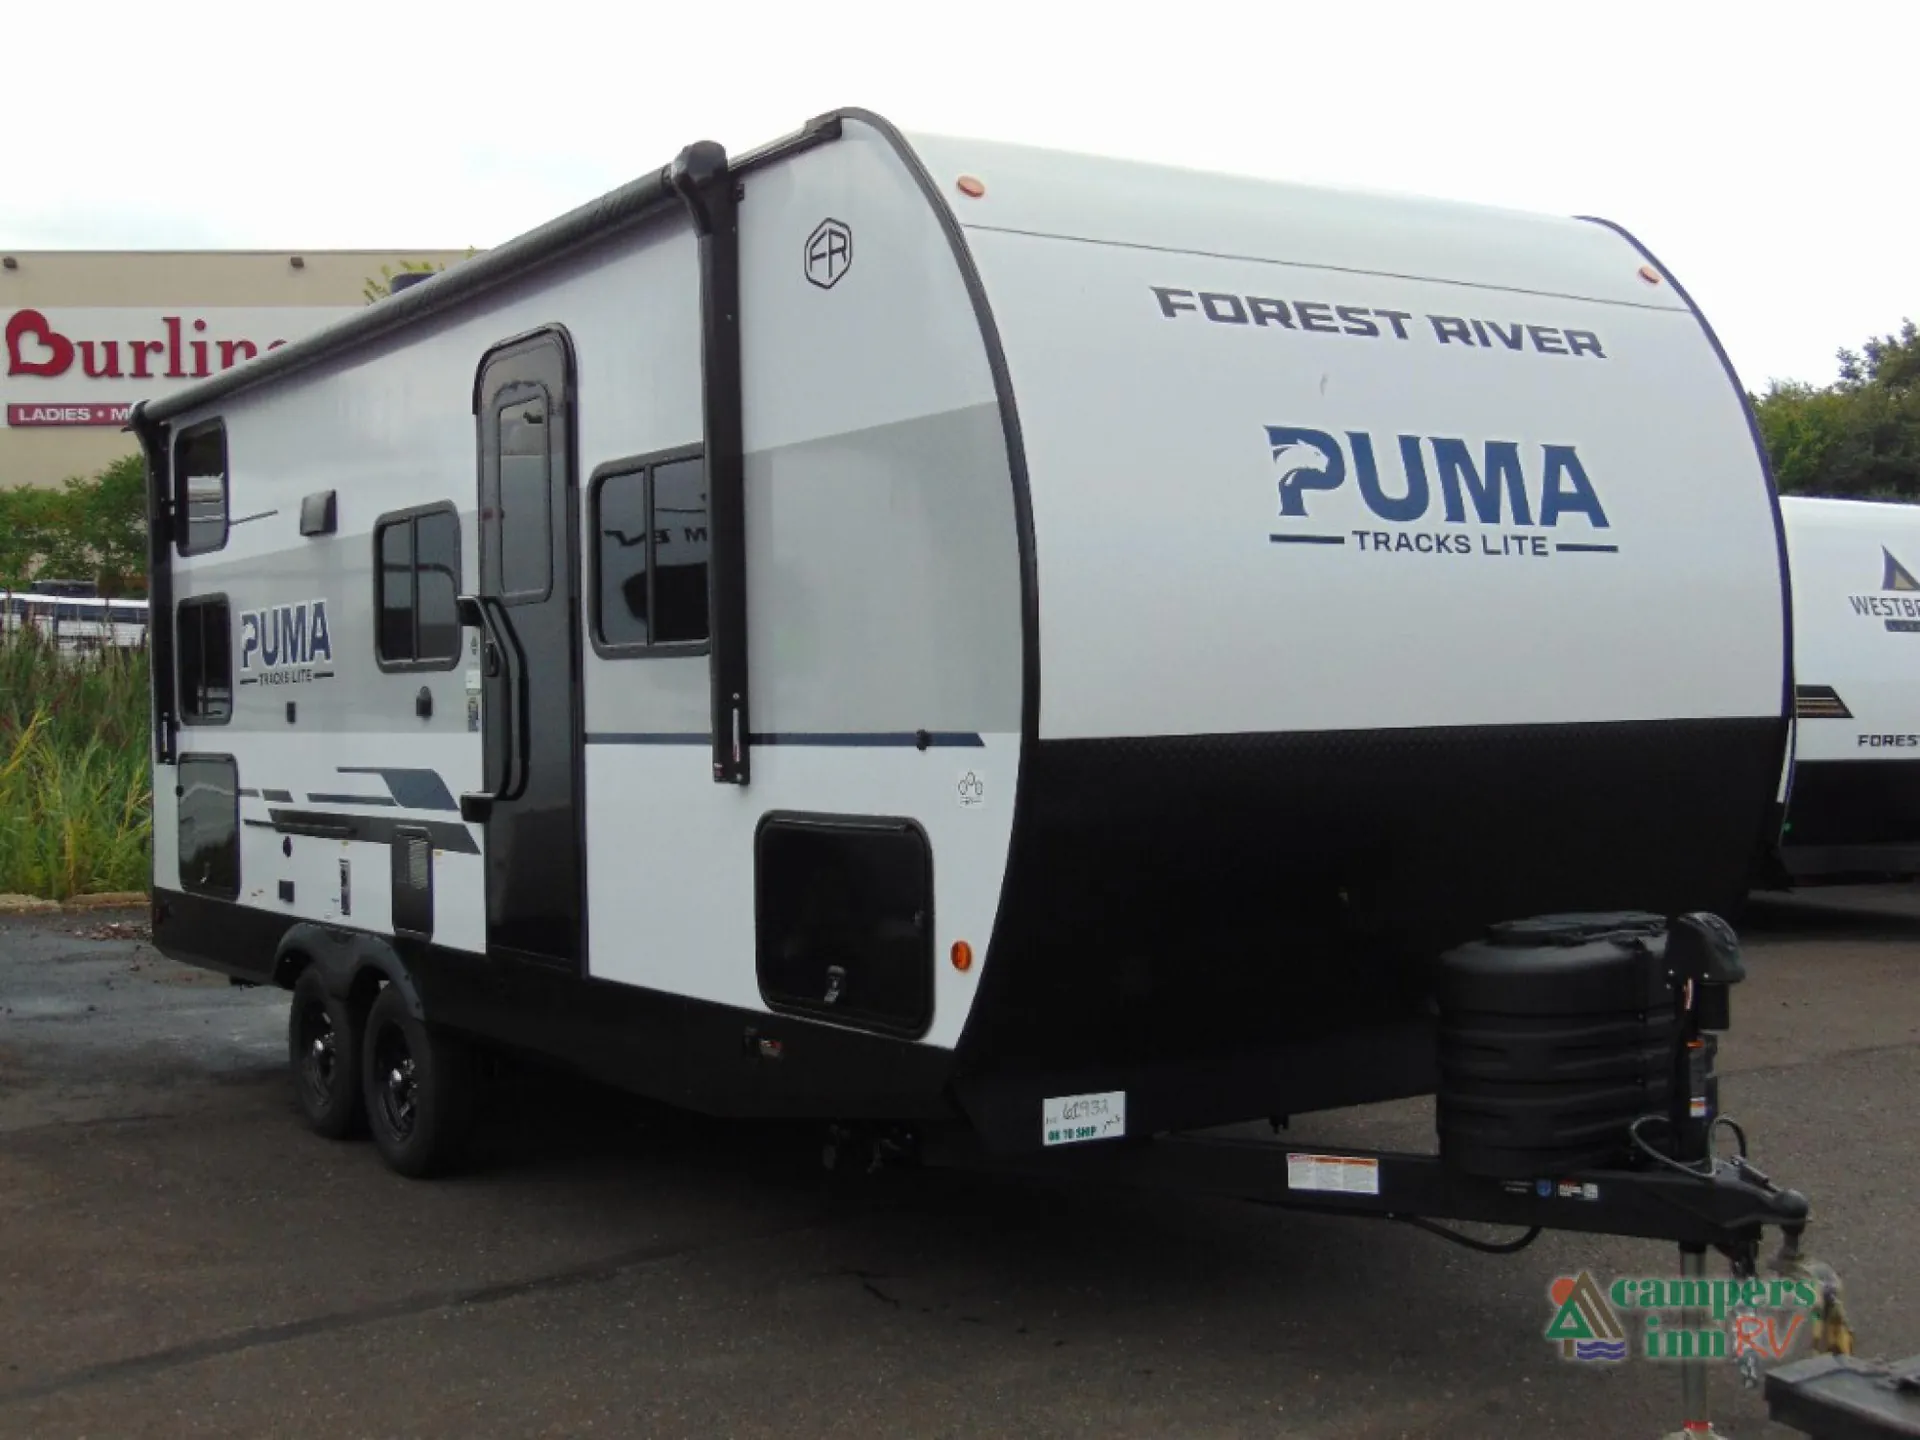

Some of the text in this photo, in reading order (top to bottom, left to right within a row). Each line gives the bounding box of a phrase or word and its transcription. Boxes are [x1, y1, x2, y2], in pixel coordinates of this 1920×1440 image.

[1149, 286, 1608, 360] FOREST RIVER
[5, 308, 288, 379] Burlin
[18, 407, 91, 422] LADIES
[1263, 424, 1611, 529] PUMA
[1352, 530, 1549, 557] TRACKS LITE
[241, 601, 331, 668] PUMA
[259, 668, 313, 686] TRACKS LITE
[1857, 734, 1920, 748] FORES
[1076, 1125, 1098, 1139] SHIP
